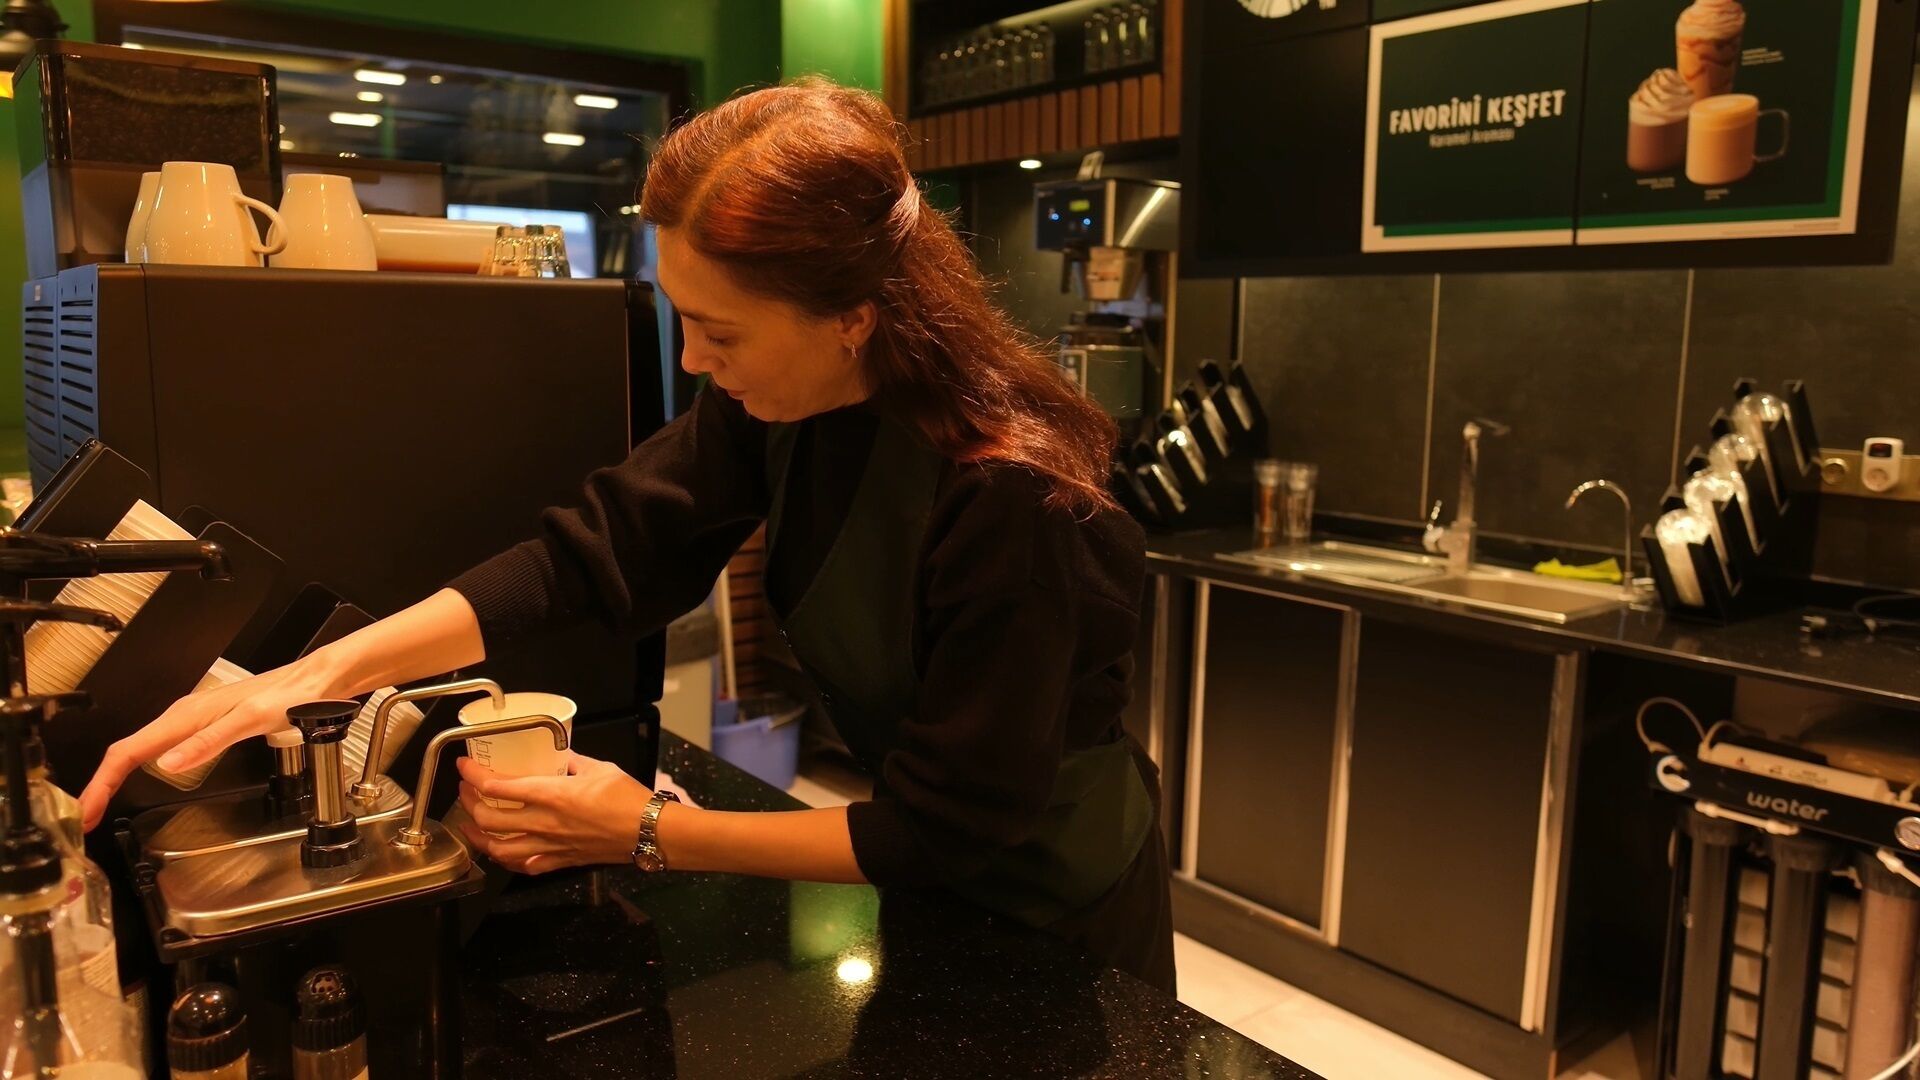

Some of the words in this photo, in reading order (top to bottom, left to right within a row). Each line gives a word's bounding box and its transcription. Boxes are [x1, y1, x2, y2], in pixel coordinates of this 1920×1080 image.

[1389, 94, 1482, 135] FAVORİNİ
[1487, 89, 1567, 128] KEŞFET
[1747, 791, 1828, 821] water
